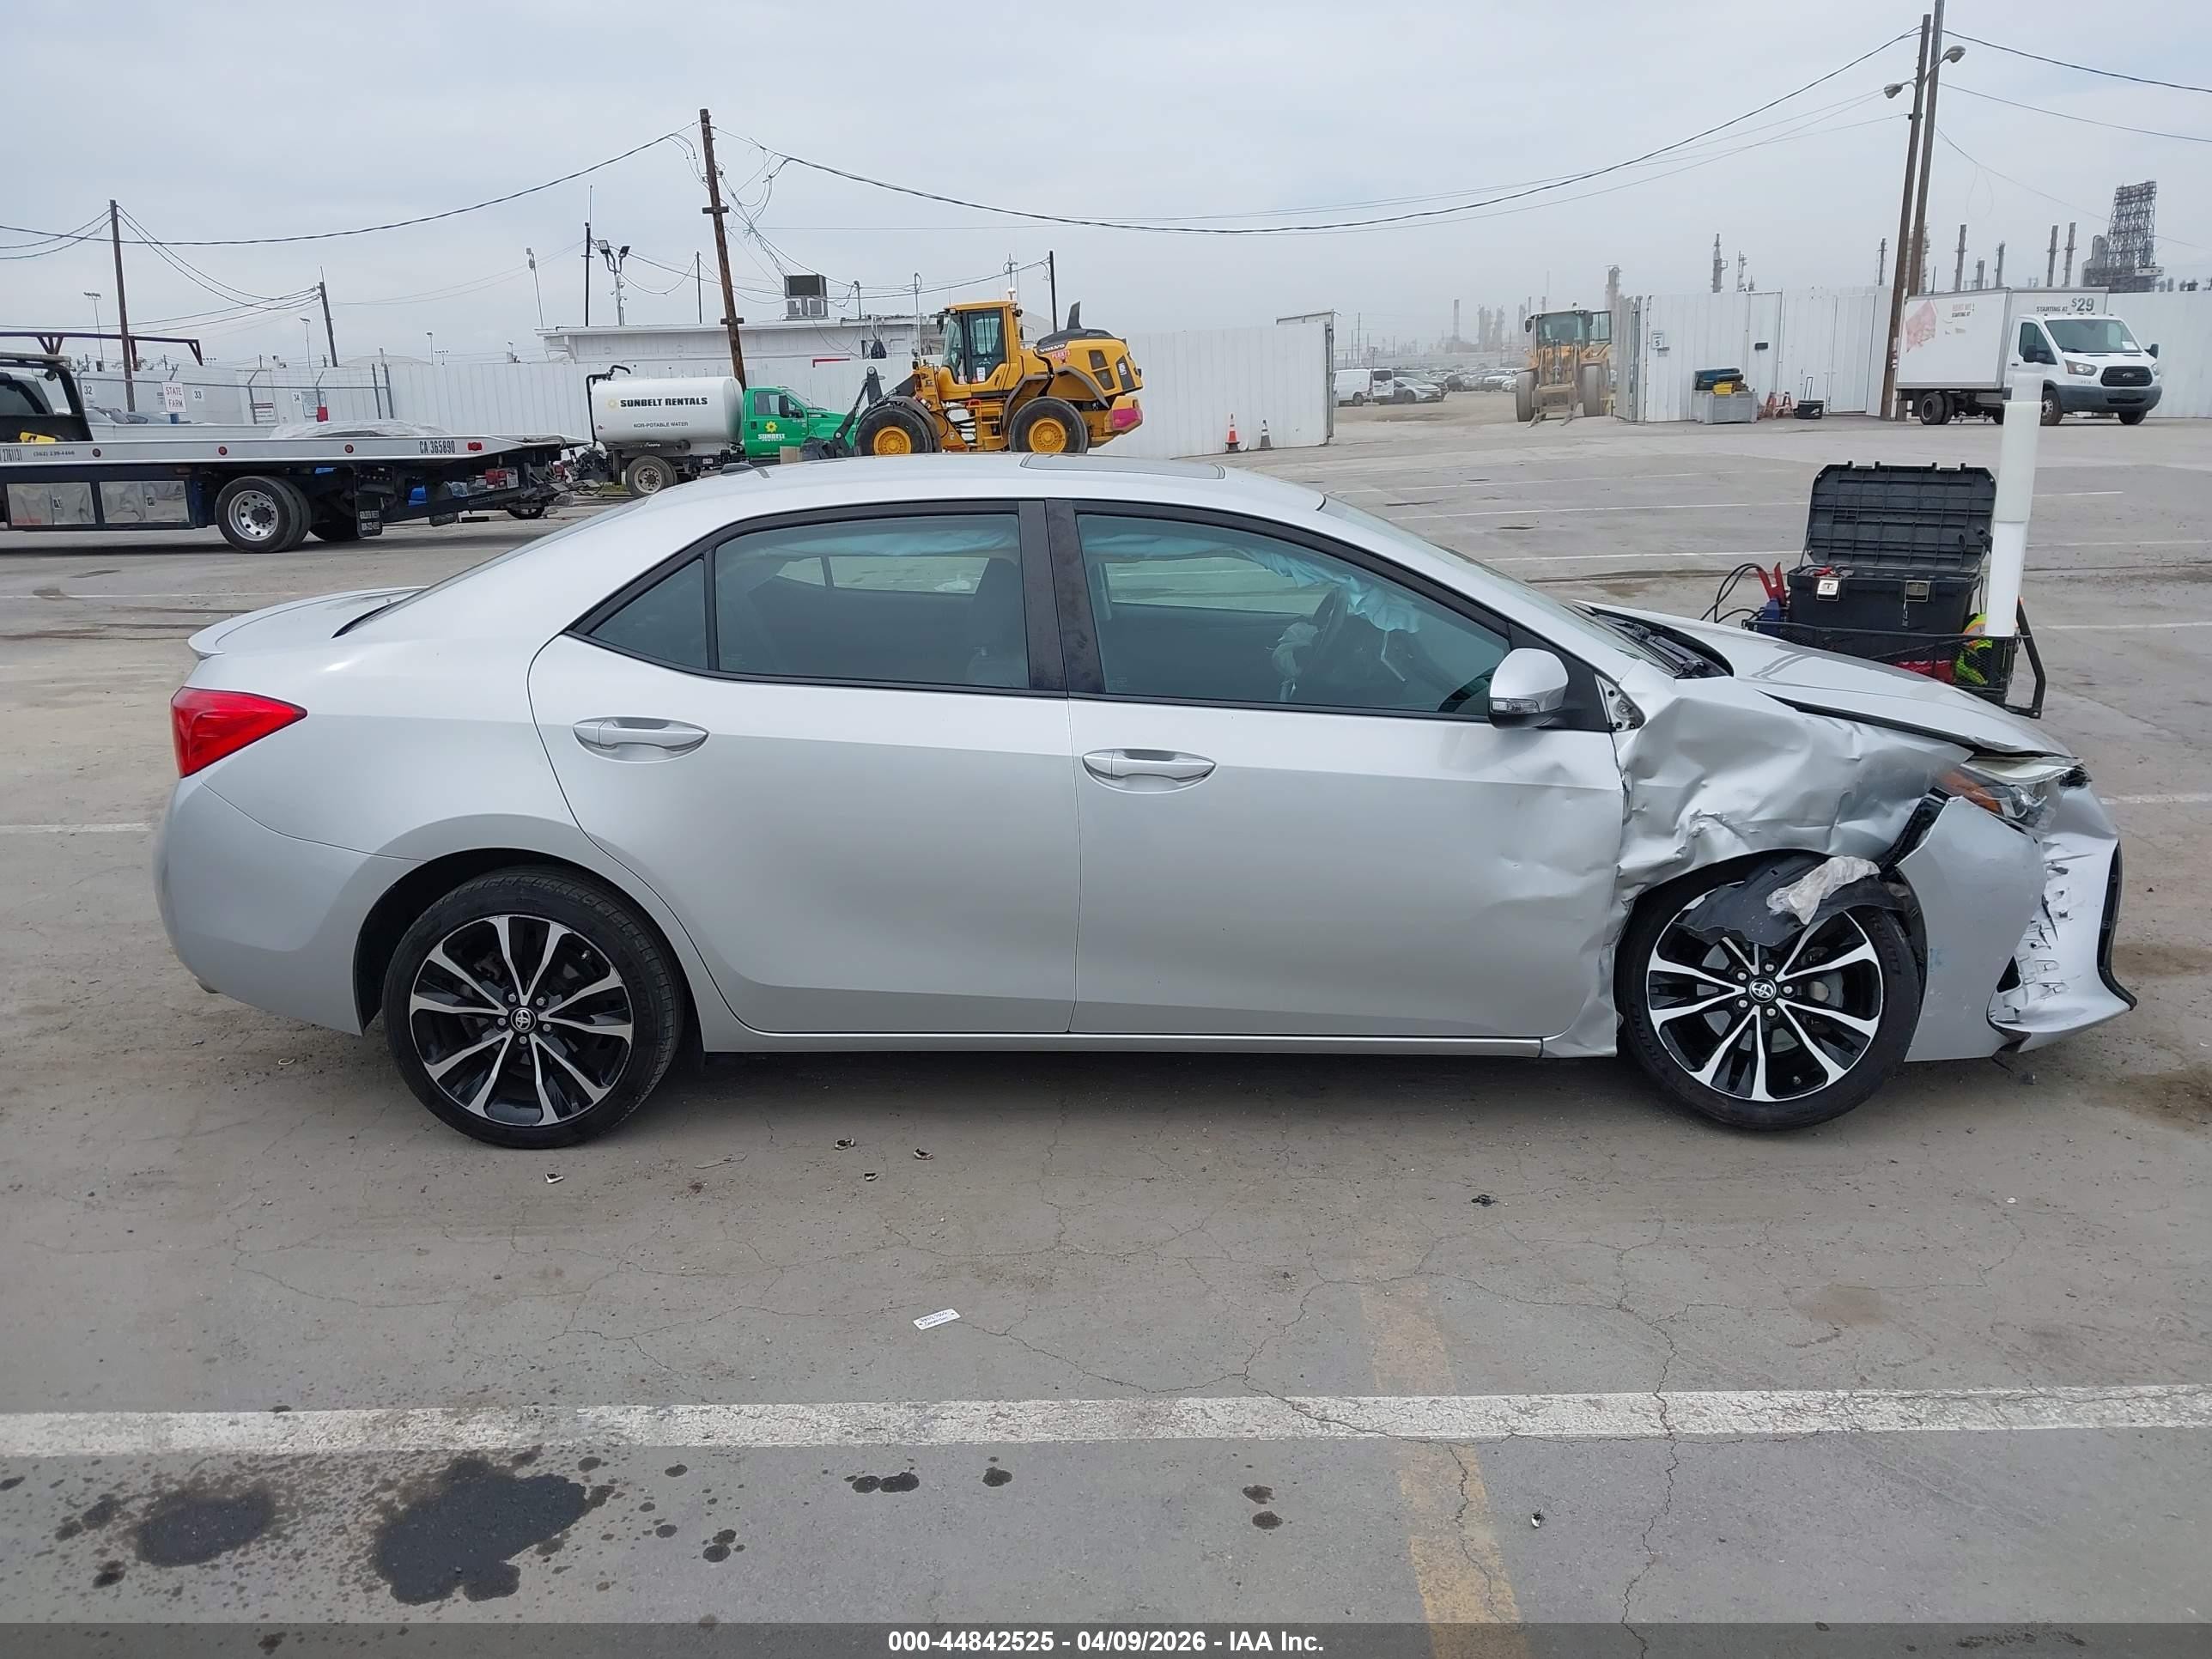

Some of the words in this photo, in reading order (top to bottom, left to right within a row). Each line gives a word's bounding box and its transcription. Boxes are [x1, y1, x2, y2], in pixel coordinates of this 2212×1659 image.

[2071, 297, 2094, 312] $29
[1039, 343, 1065, 353] VOLVO
[84, 386, 92, 395] 32
[165, 386, 182, 396] STATE
[194, 391, 202, 399] 33
[168, 398, 183, 408] FARM
[620, 398, 663, 407] SUNBELT
[665, 397, 708, 406] RENTALS
[419, 441, 428, 453] CA
[430, 440, 455, 453] 365890
